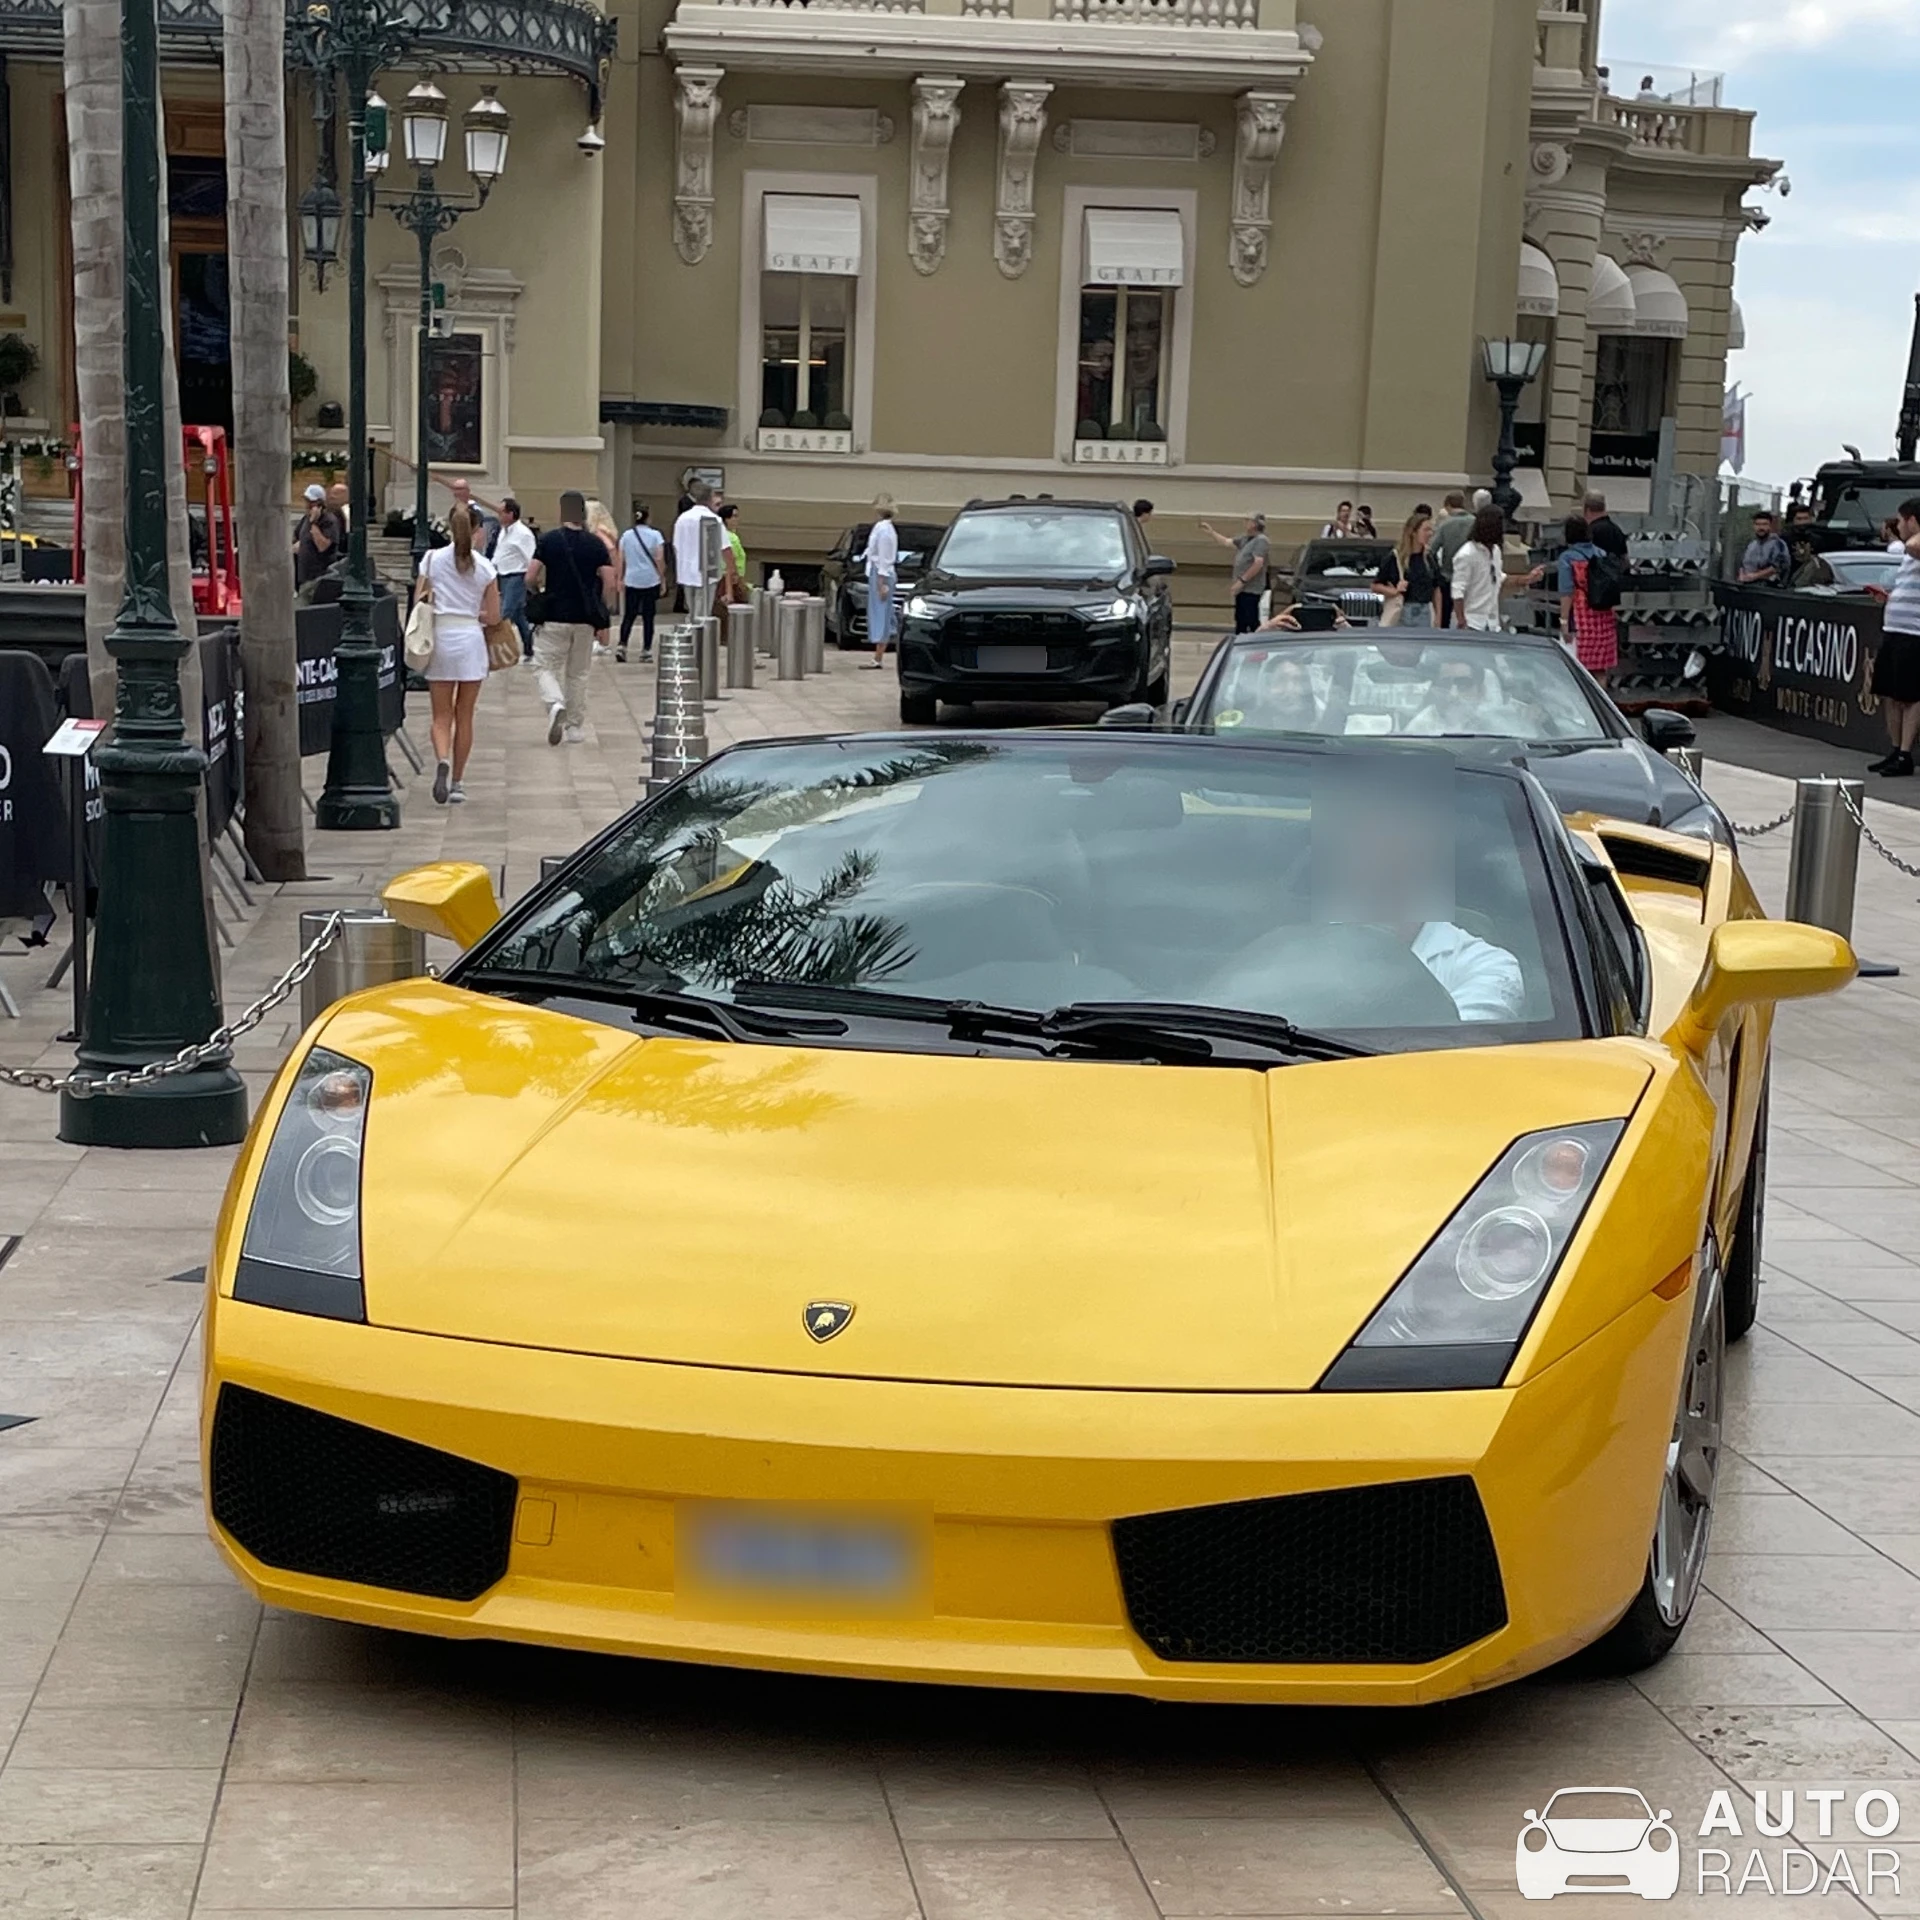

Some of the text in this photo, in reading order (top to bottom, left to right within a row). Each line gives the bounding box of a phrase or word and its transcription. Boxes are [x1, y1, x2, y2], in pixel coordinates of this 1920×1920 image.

[772, 254, 856, 272] GRAFF
[1097, 266, 1177, 283] GRAFF
[764, 433, 845, 450] GRAFF
[1082, 445, 1161, 461] GRAFF
[1776, 687, 1811, 718] MONTE
[1814, 695, 1848, 728] CARLO
